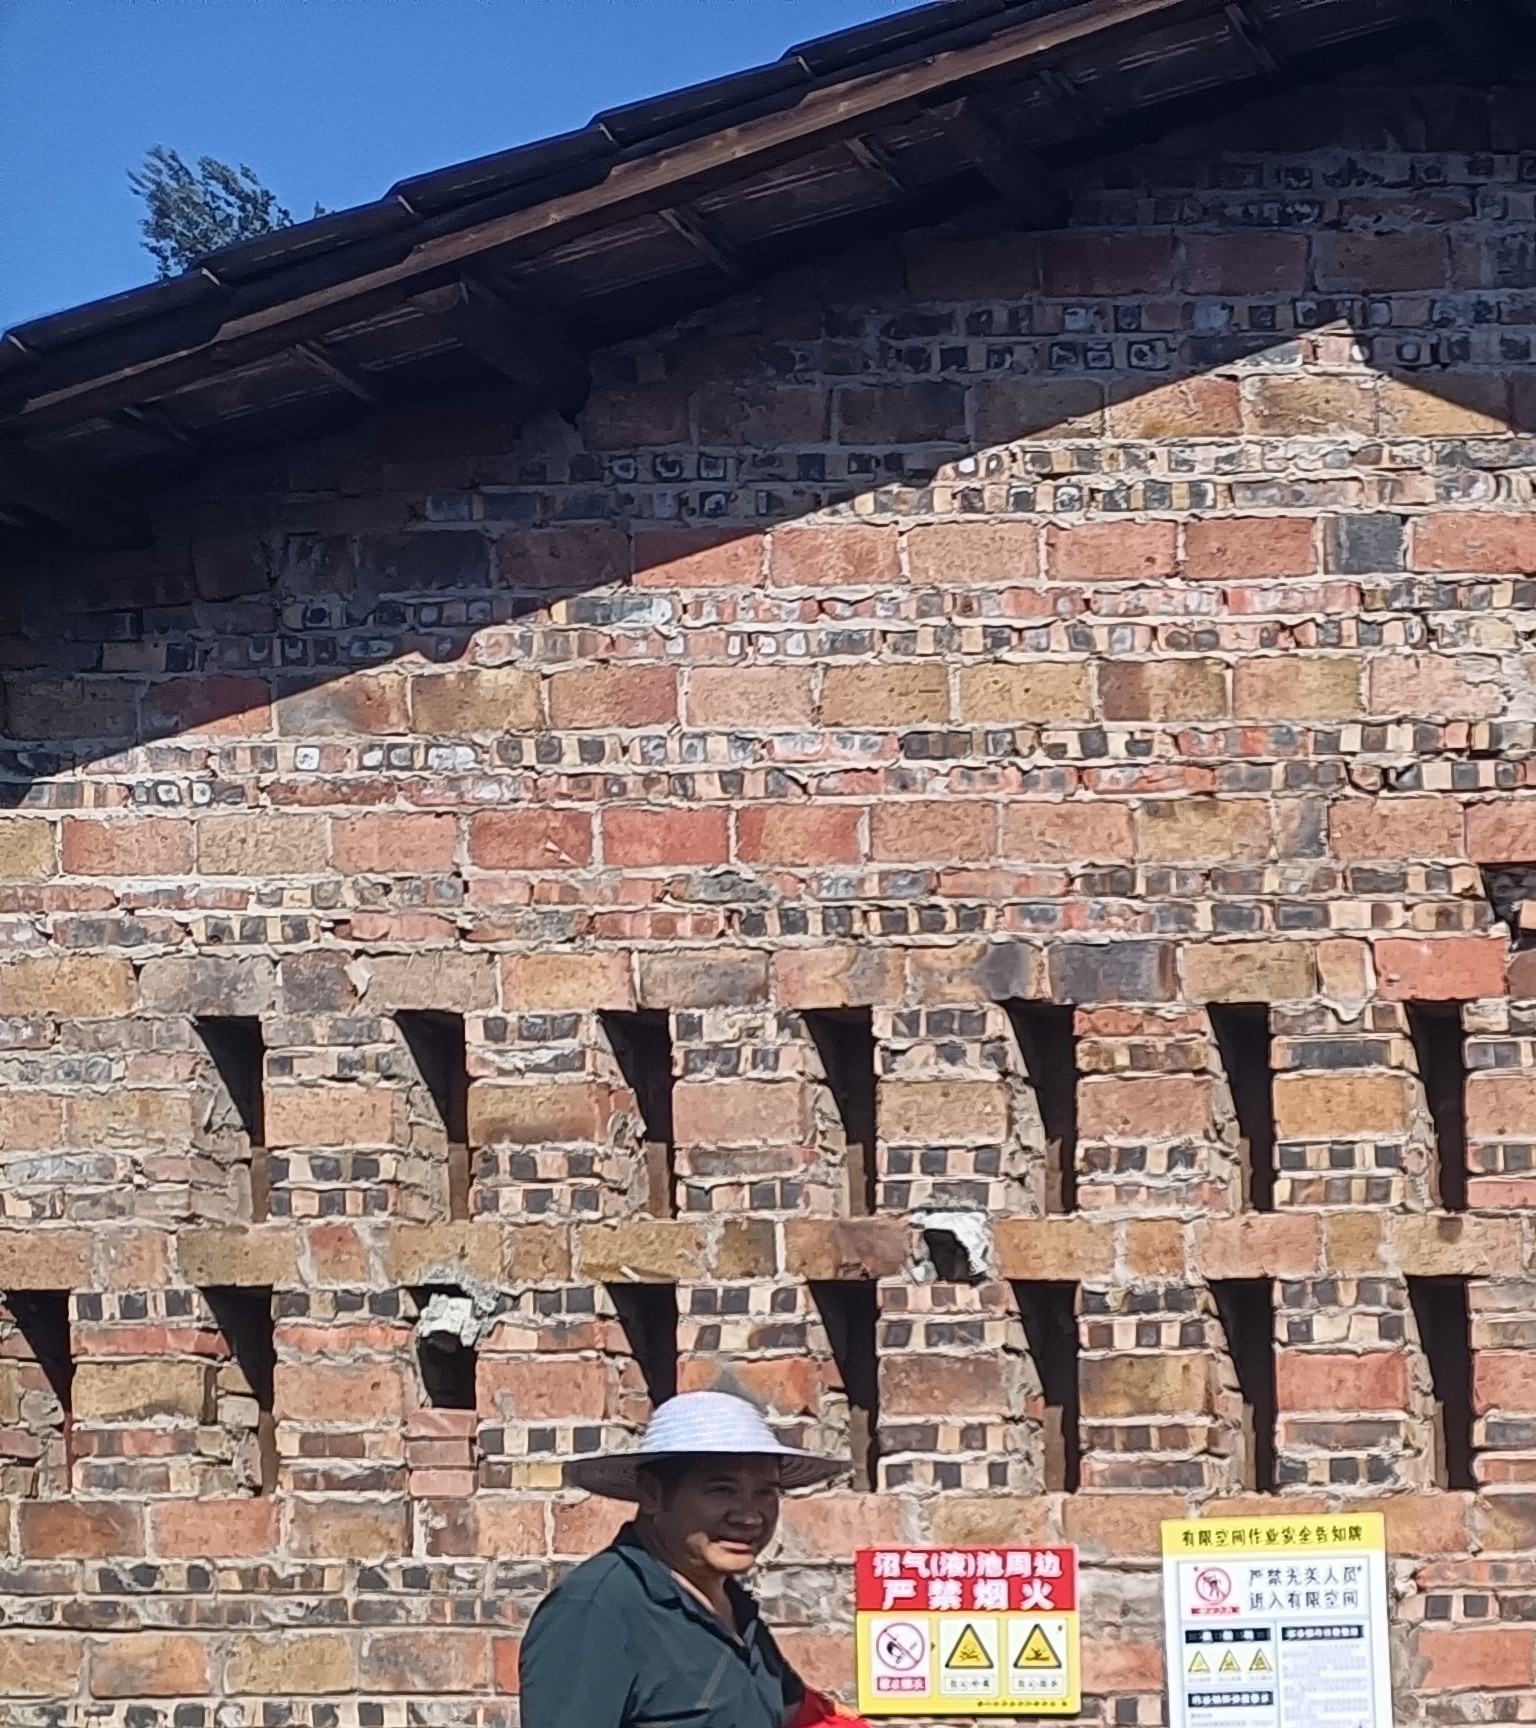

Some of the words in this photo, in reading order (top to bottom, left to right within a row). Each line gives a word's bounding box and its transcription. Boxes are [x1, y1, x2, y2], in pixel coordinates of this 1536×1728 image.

[1182, 1525, 1363, 1547] 有限空间作业安全告知牌
[872, 1551, 1063, 1579] 沼气(液)池周边
[881, 1578, 1055, 1612] 严禁烟火
[1249, 1590, 1359, 1612] 进入有限空间
